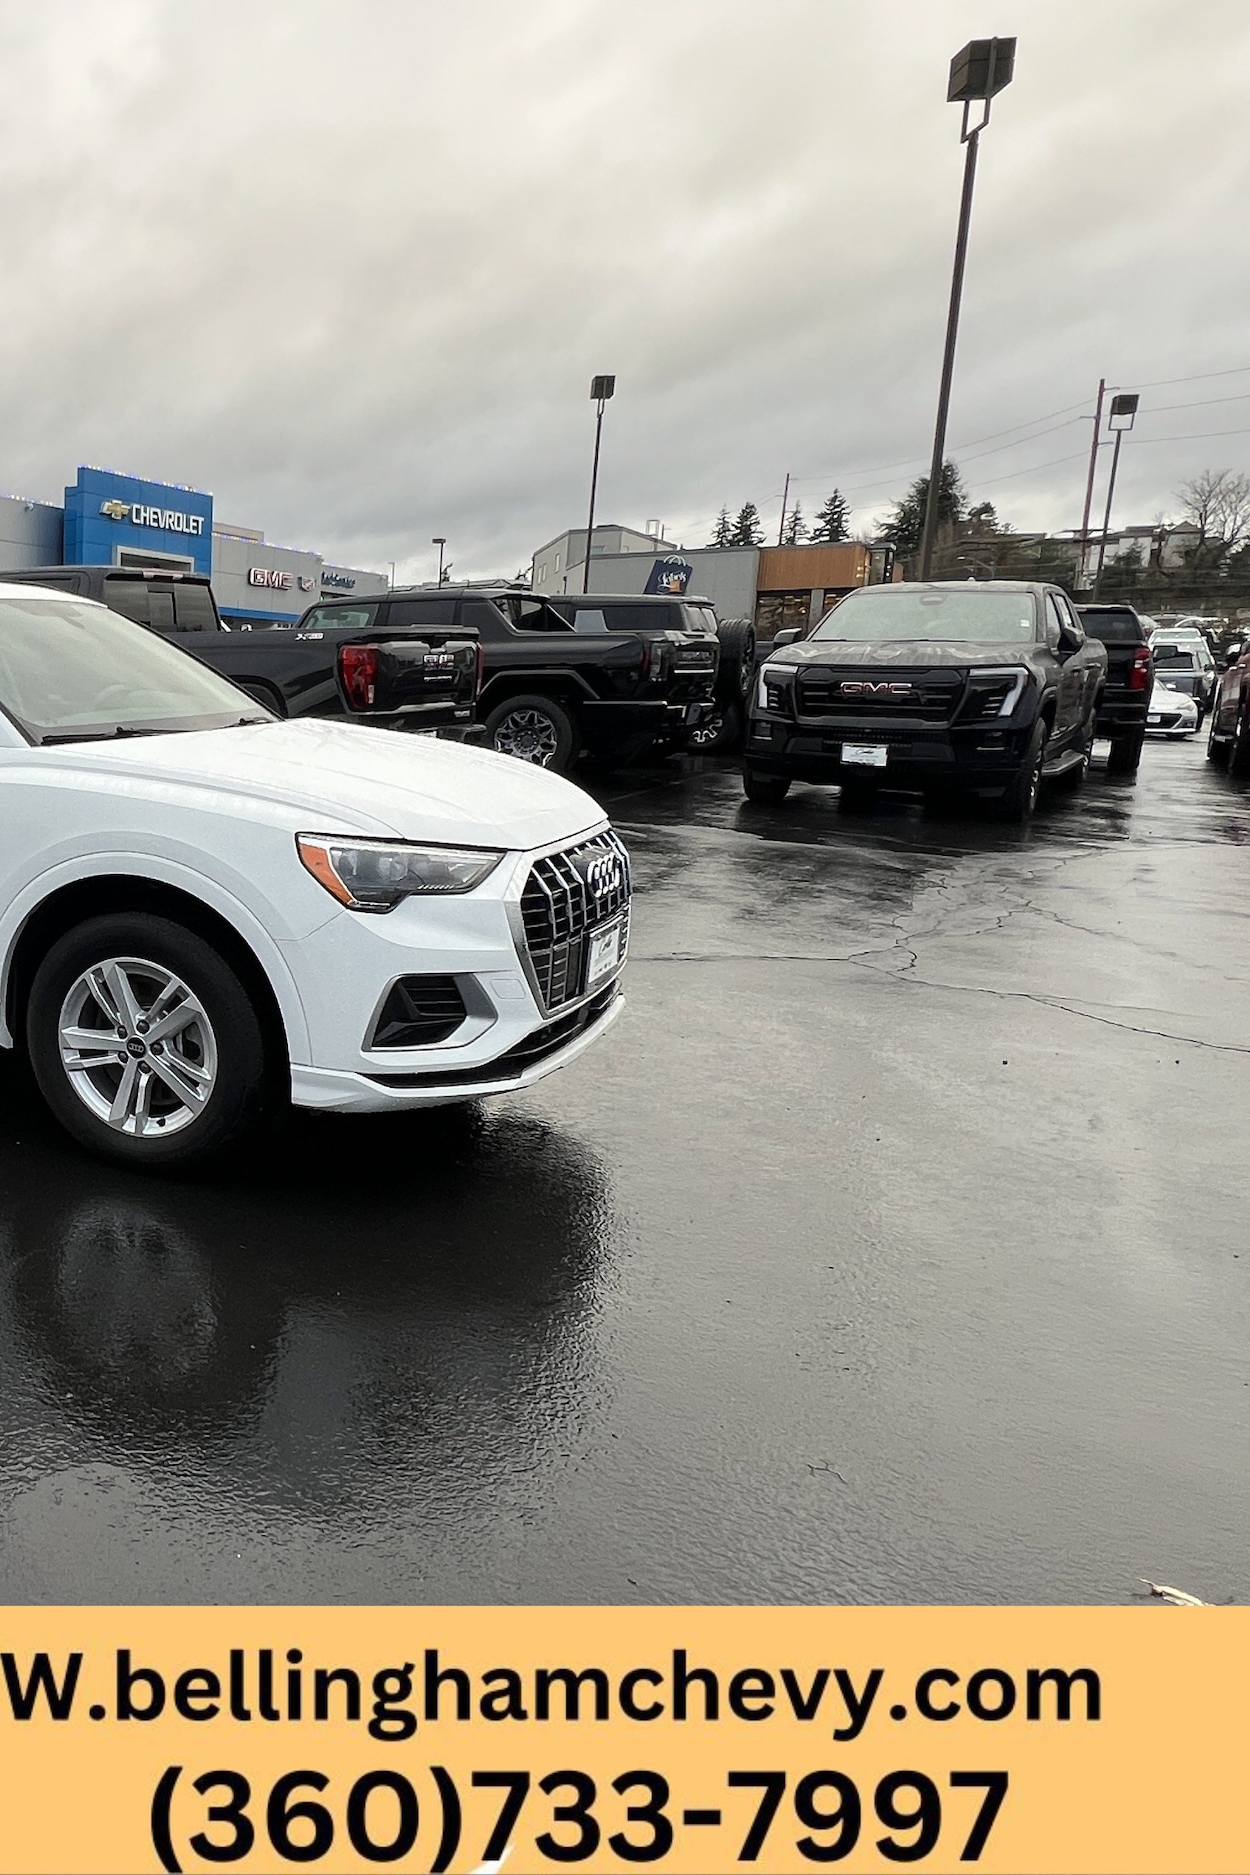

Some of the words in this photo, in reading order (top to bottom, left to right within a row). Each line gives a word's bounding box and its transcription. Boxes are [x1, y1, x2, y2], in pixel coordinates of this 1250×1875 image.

[132, 504, 204, 535] CHEVROLET
[249, 567, 293, 590] GMC
[841, 682, 912, 694] GMC
